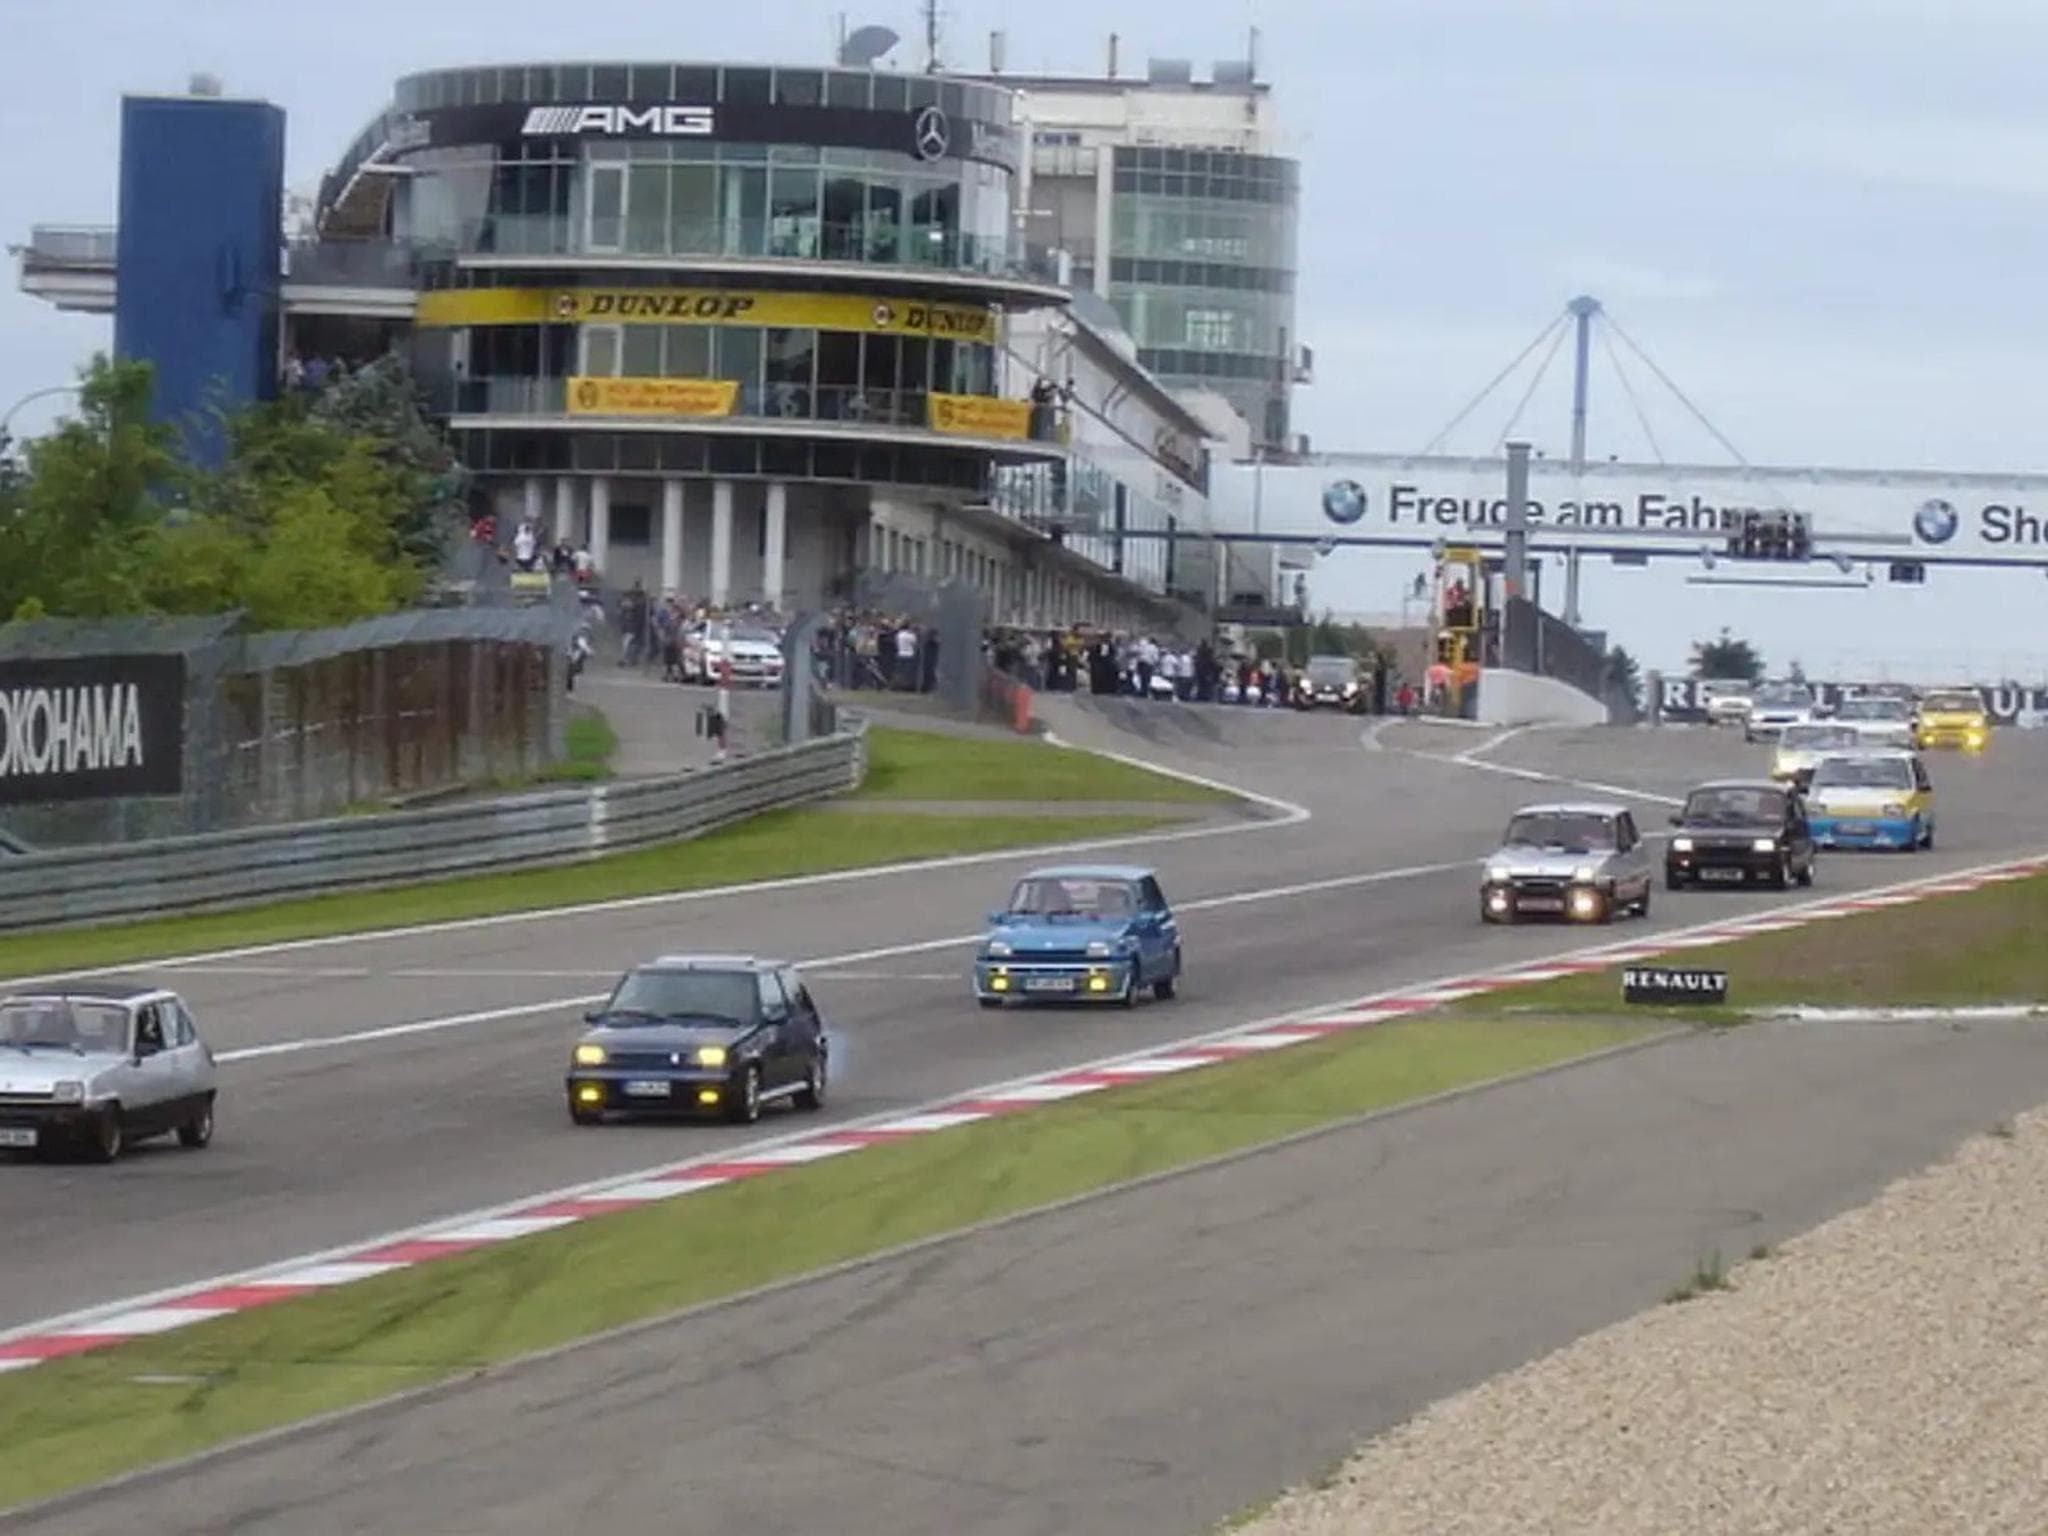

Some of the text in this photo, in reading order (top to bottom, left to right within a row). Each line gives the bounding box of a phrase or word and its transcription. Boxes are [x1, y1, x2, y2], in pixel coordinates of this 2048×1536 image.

[572, 106, 714, 134] AMG
[587, 293, 756, 318] DUNLOP
[1556, 500, 1622, 526] am
[1979, 504, 2048, 544] Sh
[1623, 970, 1728, 991] RENAULT
